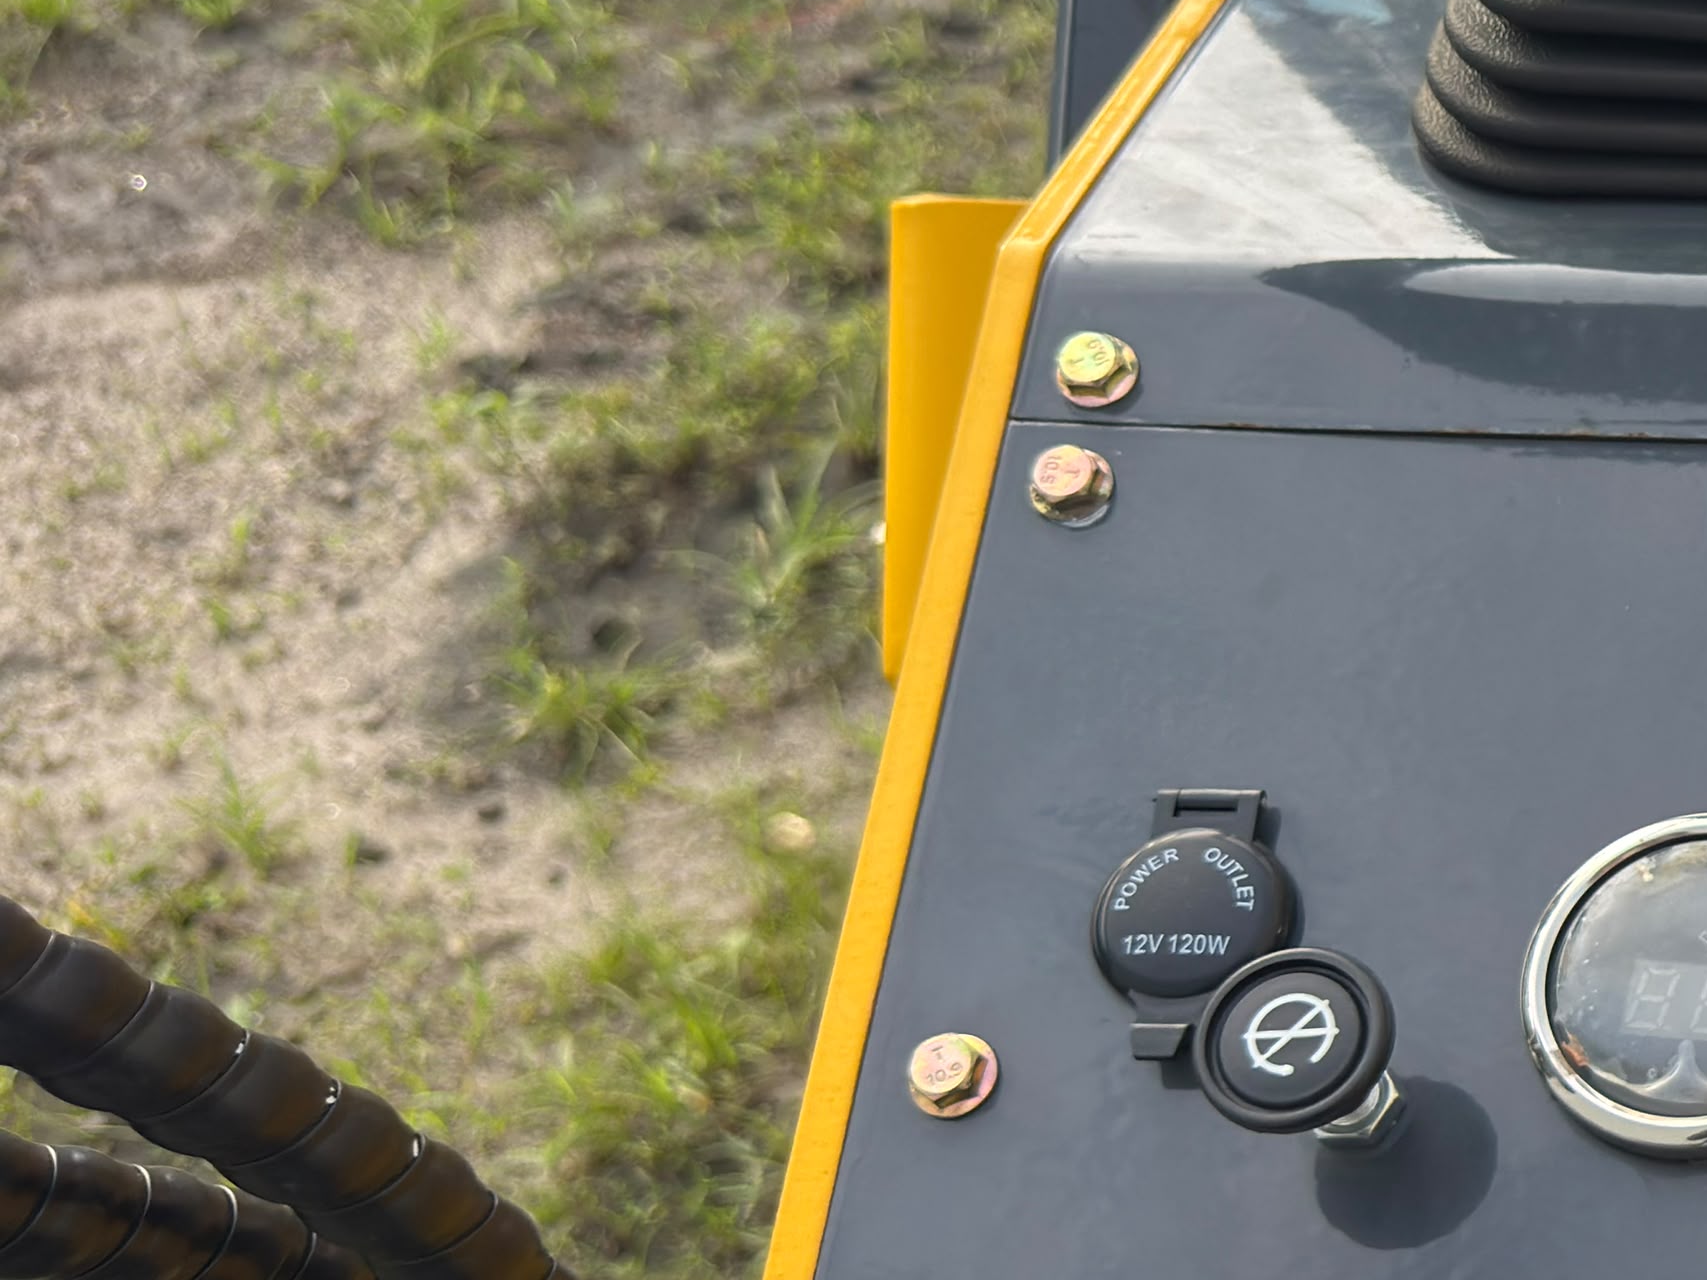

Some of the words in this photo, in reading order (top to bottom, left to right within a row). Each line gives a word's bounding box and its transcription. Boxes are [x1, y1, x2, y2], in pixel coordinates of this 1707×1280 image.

[1113, 846, 1180, 910] POWER
[1203, 846, 1255, 911] OUTLET
[1123, 933, 1165, 955] 12V
[1168, 933, 1231, 956] 120W
